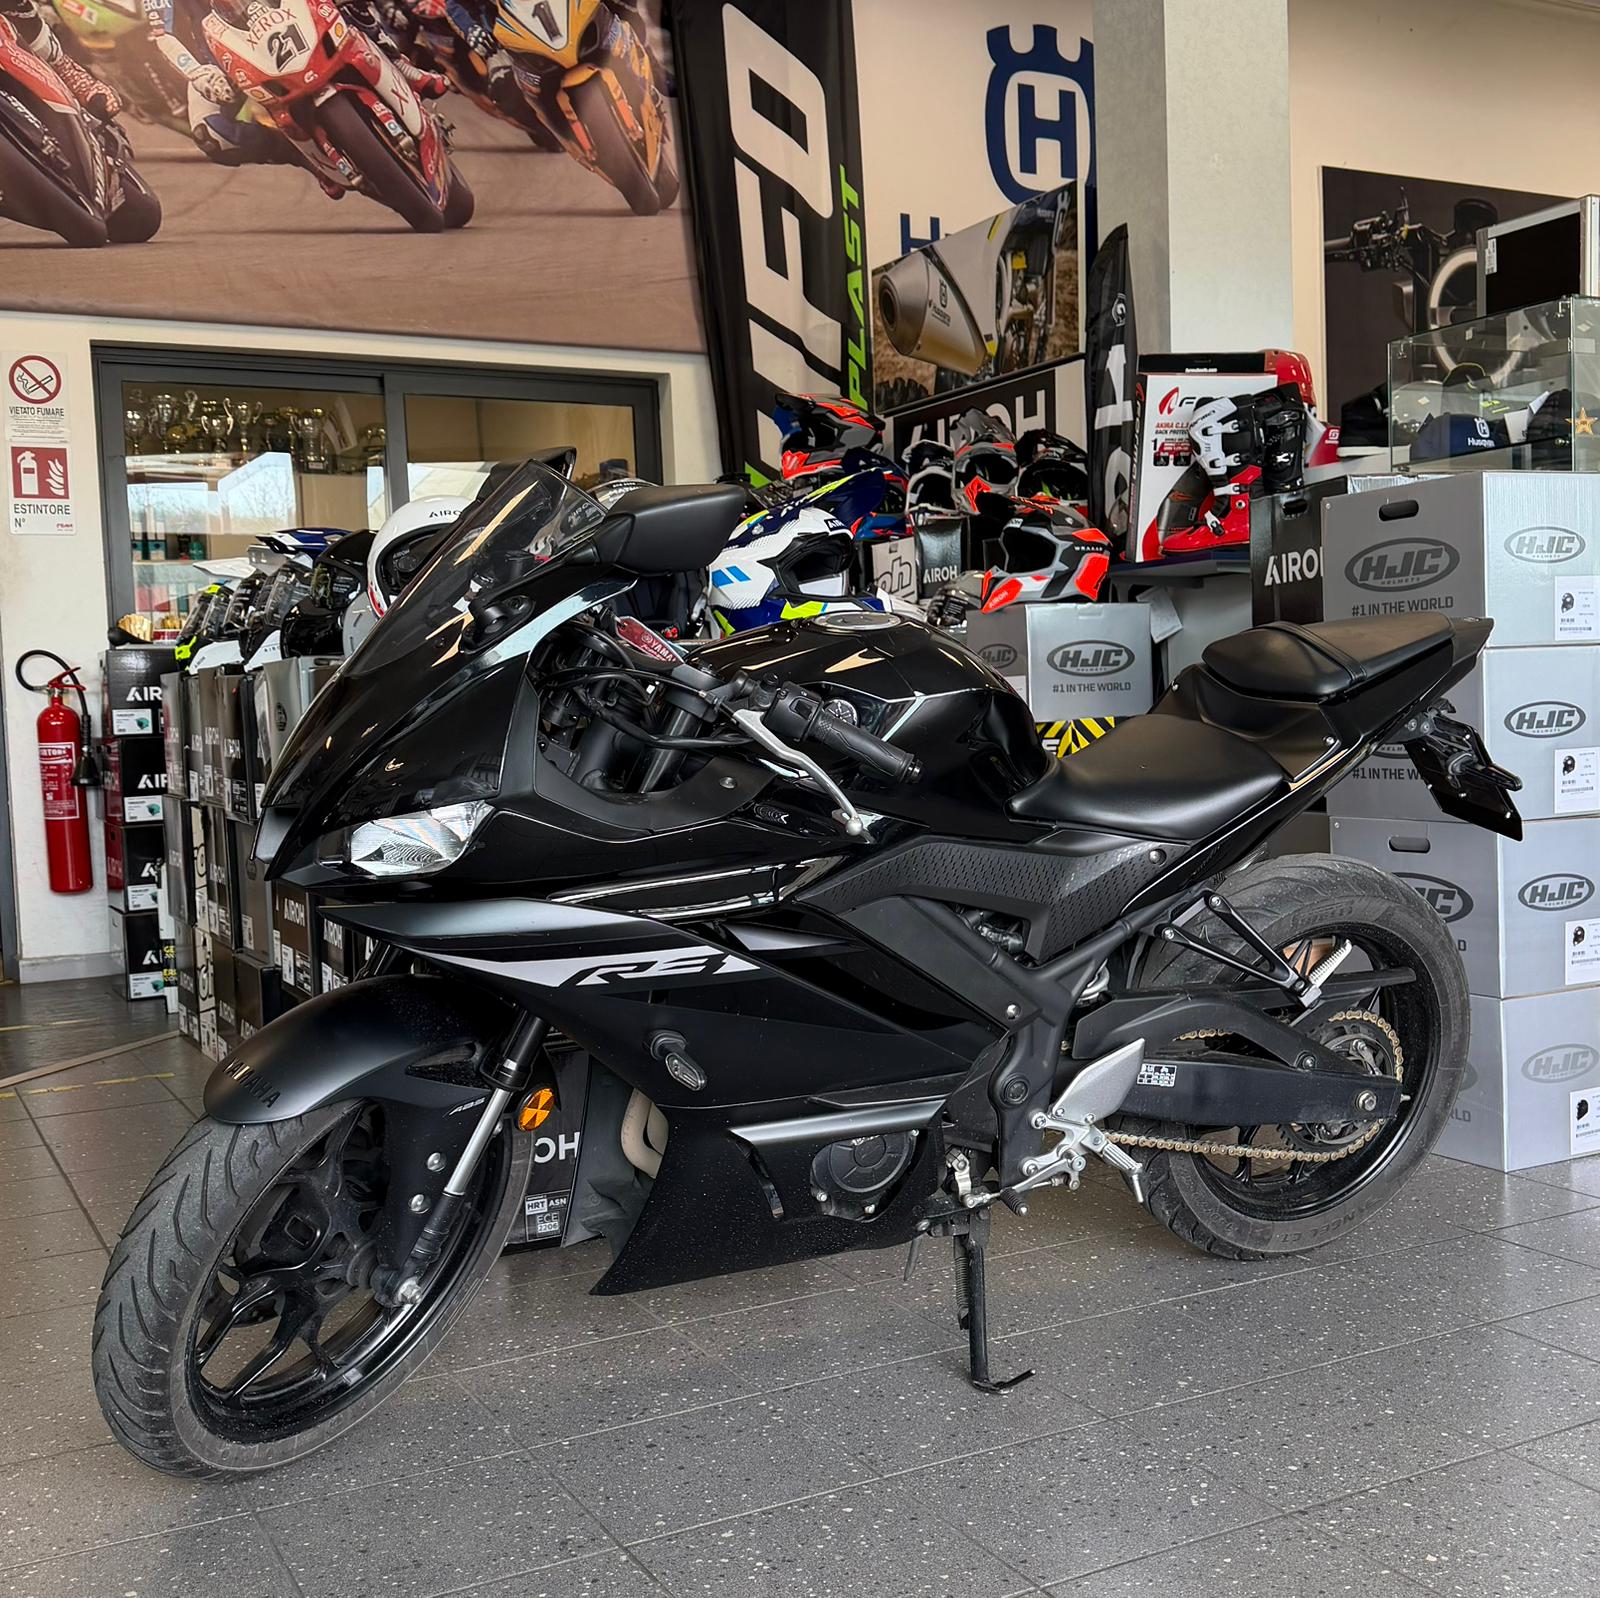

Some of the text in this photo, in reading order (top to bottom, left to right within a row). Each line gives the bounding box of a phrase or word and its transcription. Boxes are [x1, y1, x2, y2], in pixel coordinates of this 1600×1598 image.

[247, 8, 297, 50] XEROX
[532, 2, 562, 41] 1
[267, 23, 310, 72] 21
[839, 164, 869, 412] PLAST
[9, 406, 64, 417] VIETATO FUMARE
[13, 503, 70, 515] ESTINTORE
[14, 517, 25, 528] N°
[1515, 536, 1576, 554] HJC
[1264, 546, 1323, 586] AIRO
[1359, 546, 1444, 582] HJC
[923, 565, 958, 583] AIROH
[1351, 596, 1454, 617] #1 IN THE WORLD
[651, 638, 677, 662] YAMA
[1059, 649, 1124, 668] HJC
[1052, 682, 1131, 693] #1 IN THE WORLD
[1515, 710, 1576, 729] HJC
[1368, 768, 1380, 779] IN
[1381, 768, 1405, 780] THE
[1528, 881, 1586, 904] HJC
[1532, 1050, 1590, 1077] HJC
[222, 1056, 281, 1108] YAMAHA
[527, 1197, 567, 1210] HRT ASN
[536, 1212, 559, 1223] ECE
[537, 1221, 559, 1232] 2206
